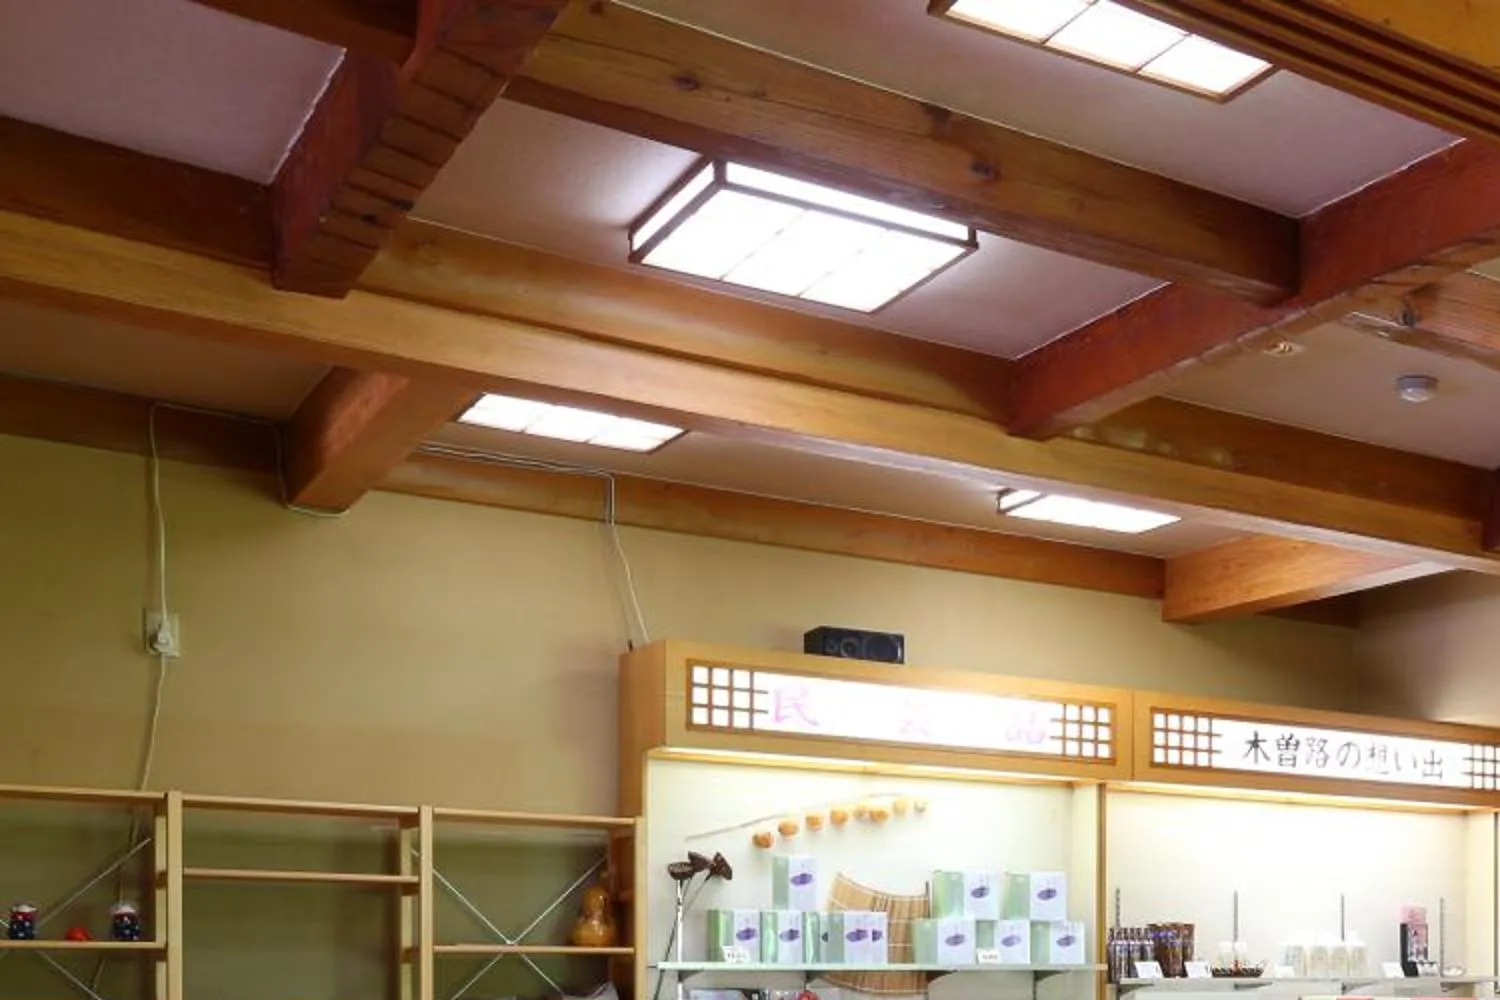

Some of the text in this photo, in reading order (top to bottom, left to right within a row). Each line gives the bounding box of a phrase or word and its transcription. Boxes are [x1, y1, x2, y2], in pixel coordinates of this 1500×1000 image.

[1244, 731, 1443, 780] 木曽路の想い出
